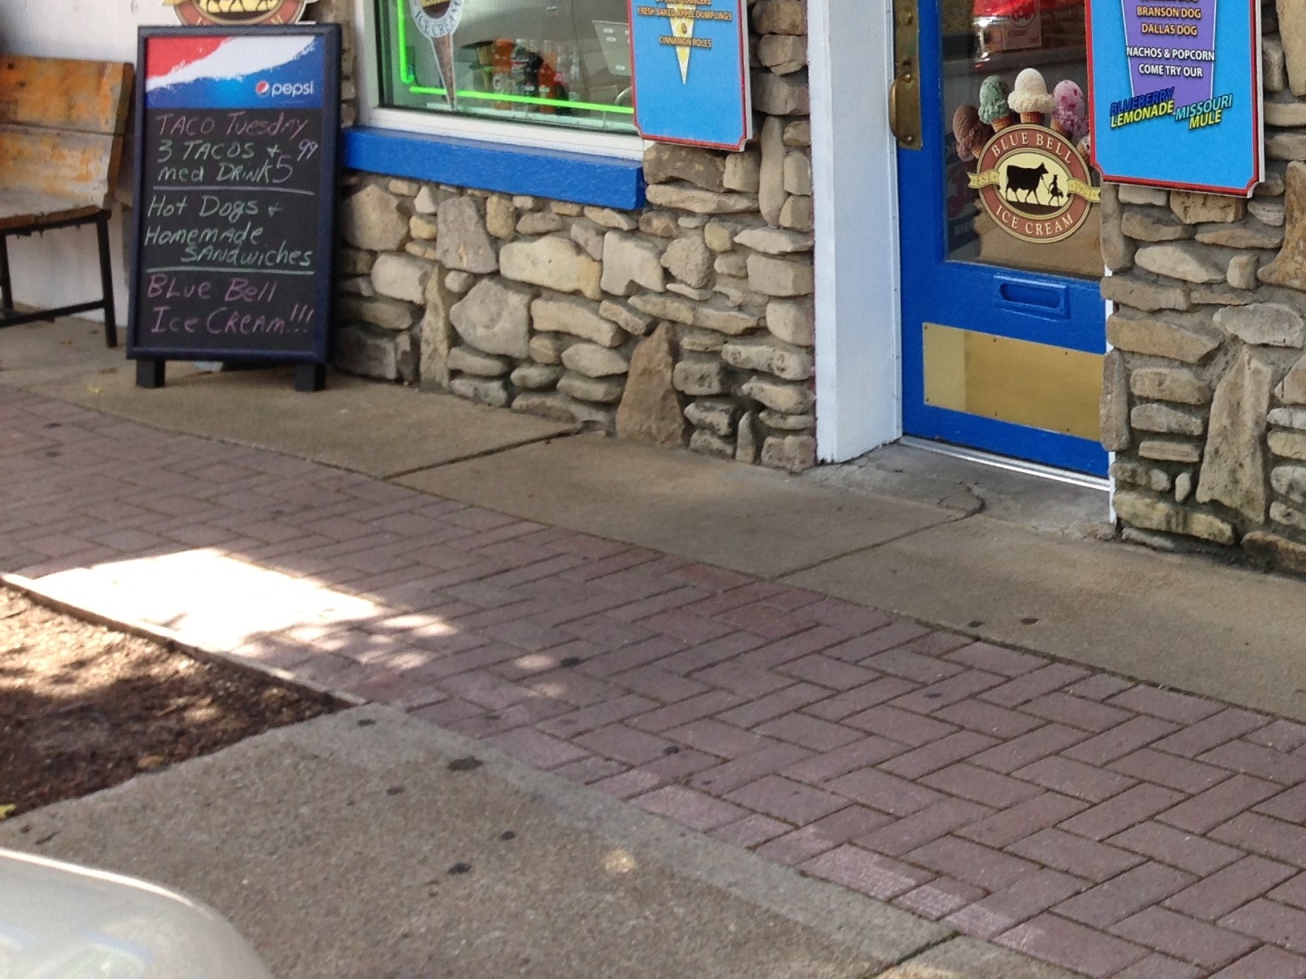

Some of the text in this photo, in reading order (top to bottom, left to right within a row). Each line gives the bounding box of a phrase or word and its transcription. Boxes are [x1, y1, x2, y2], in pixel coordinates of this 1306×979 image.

[1137, 6, 1201, 18] BRANSON DOG
[1142, 23, 1197, 35] DALLAS DOG
[1126, 47, 1214, 60] NACHOS & POPCORN
[1138, 64, 1203, 77] COME TRY OUR
[271, 81, 314, 97] pepsi
[1110, 87, 1175, 115] BLUEBERRY
[1111, 100, 1174, 128] LEMONADE
[1175, 94, 1233, 120] MISSOURI
[156, 113, 215, 136] TACO
[1189, 110, 1222, 129] MULE
[157, 139, 173, 163] 3
[183, 140, 255, 160] TACOS
[992, 133, 1071, 164] BLUE BELL
[272, 139, 318, 184] 5 99
[158, 166, 204, 182] med
[147, 195, 188, 217] Hot
[199, 195, 259, 223] Dogs
[996, 206, 1018, 229] ICE
[1025, 213, 1074, 235] CREAM
[224, 278, 277, 302] Bell
[151, 306, 199, 333] Ice
